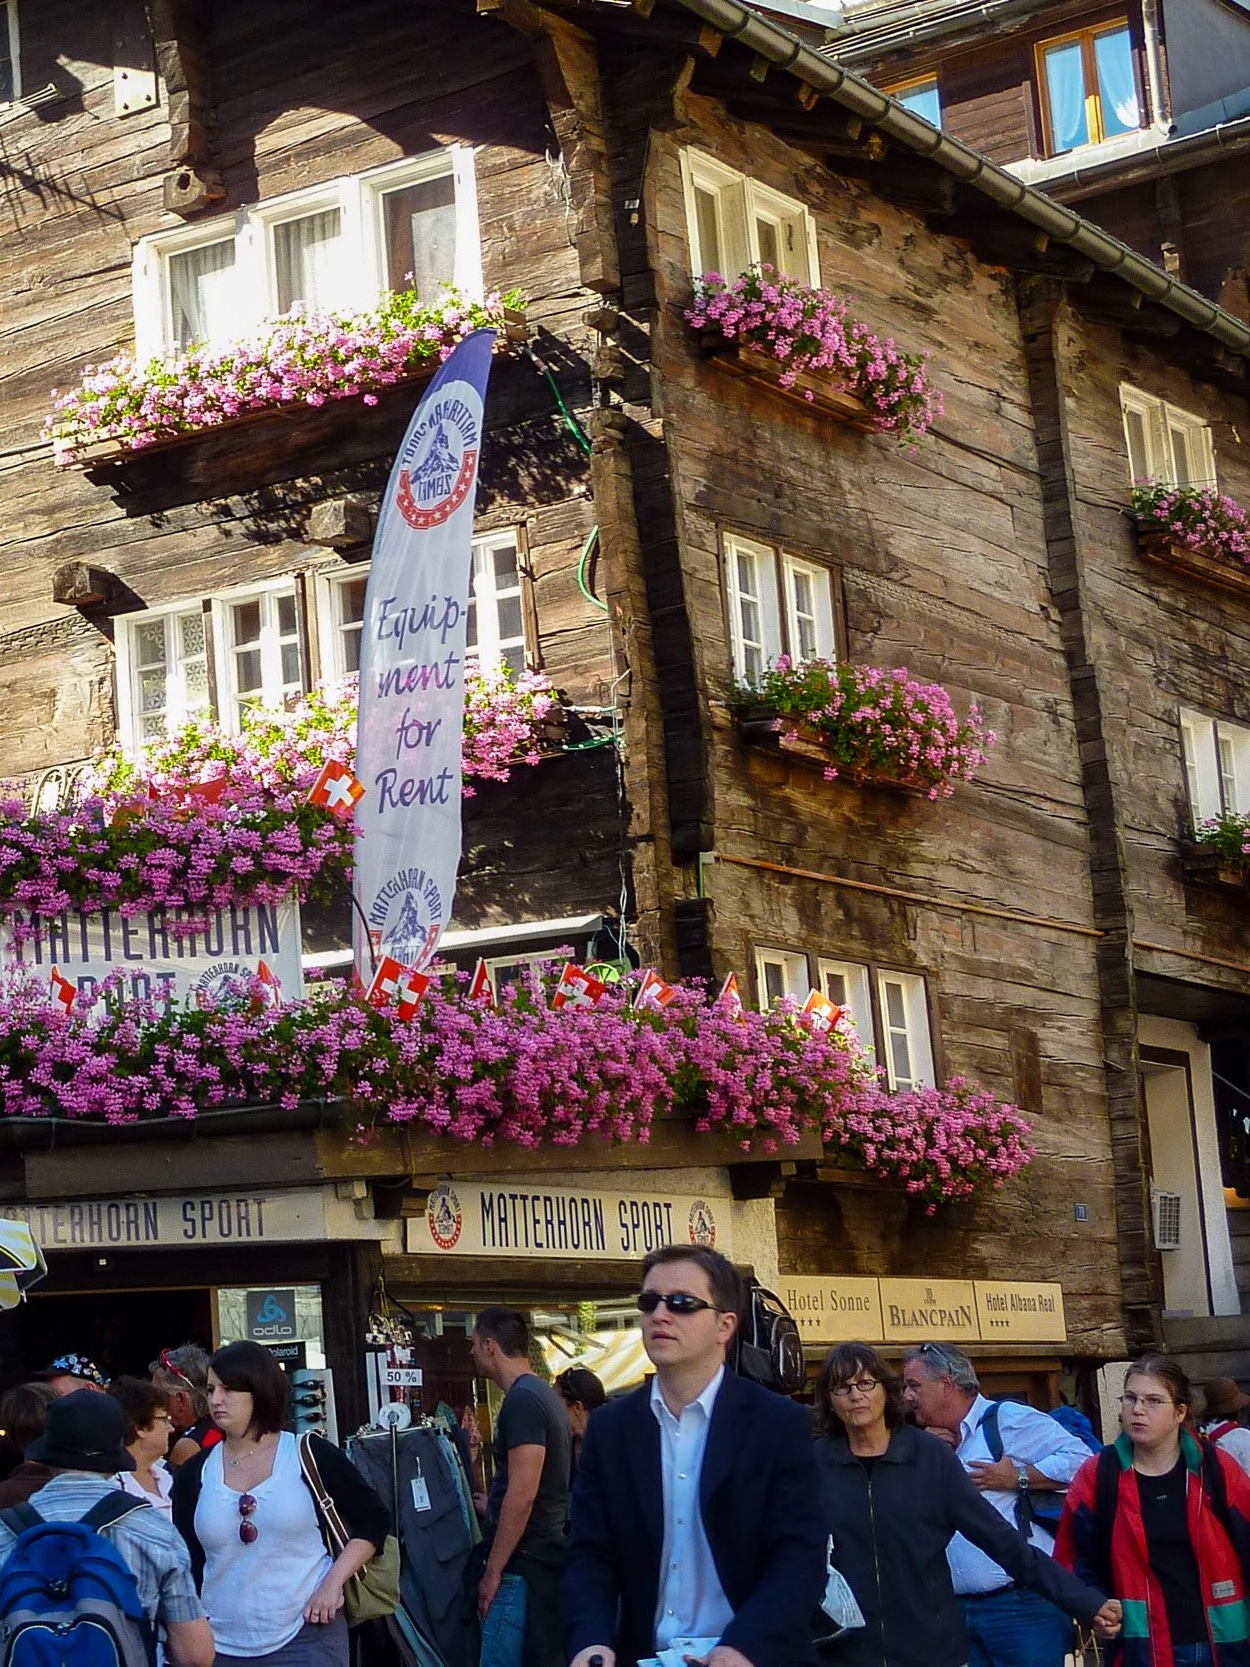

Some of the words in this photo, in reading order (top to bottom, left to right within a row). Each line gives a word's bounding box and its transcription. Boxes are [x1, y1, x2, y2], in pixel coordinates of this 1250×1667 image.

[377, 595, 466, 650] Equip-
[377, 651, 460, 699] ment
[395, 707, 442, 760] for
[375, 767, 453, 814] Rent
[423, 877, 442, 921] SPORT
[182, 1198, 266, 1240] SPORT
[480, 1191, 607, 1251] MATTERHORN
[618, 1199, 673, 1252] SPORT
[787, 1289, 824, 1312] Hotel
[830, 1290, 870, 1312] Sonne
[888, 1304, 972, 1328] BLANCPAIN
[986, 1292, 1008, 1311] Hotel
[1010, 1293, 1037, 1312] Albana
[1038, 1294, 1056, 1313] Real
[252, 1324, 293, 1336] odlo
[387, 1371, 402, 1382] 50
[405, 1371, 417, 1382] %
